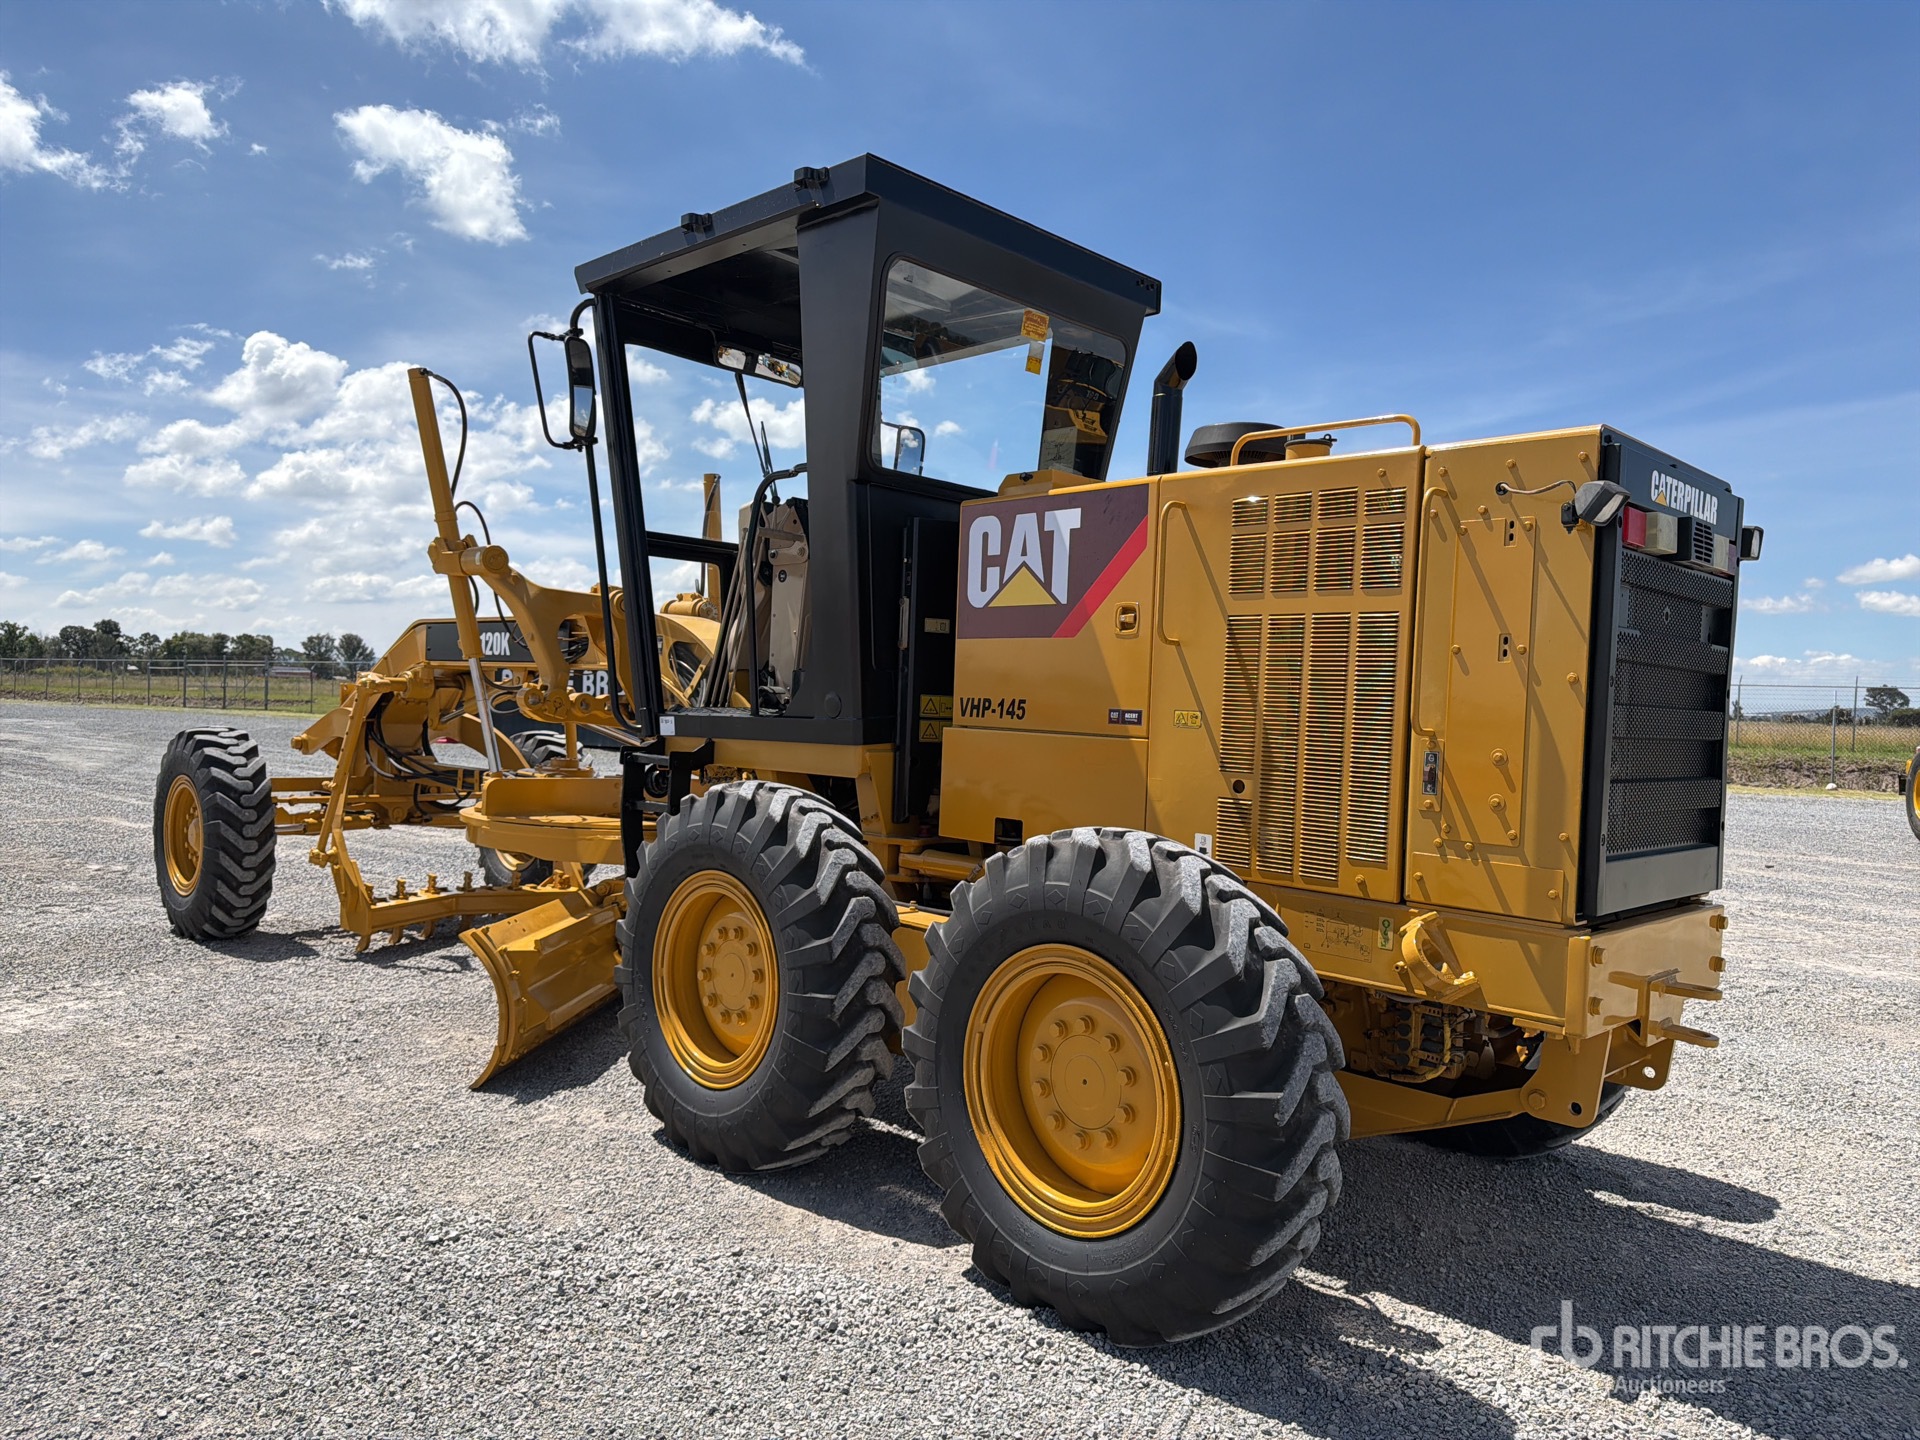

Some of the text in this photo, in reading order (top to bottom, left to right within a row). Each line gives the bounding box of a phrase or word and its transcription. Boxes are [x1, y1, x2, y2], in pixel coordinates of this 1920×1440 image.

[1652, 470, 1718, 525] CATERPILLAR
[967, 508, 1082, 608] CAT
[479, 631, 511, 657] 120K
[960, 697, 1027, 720] VHP-145
